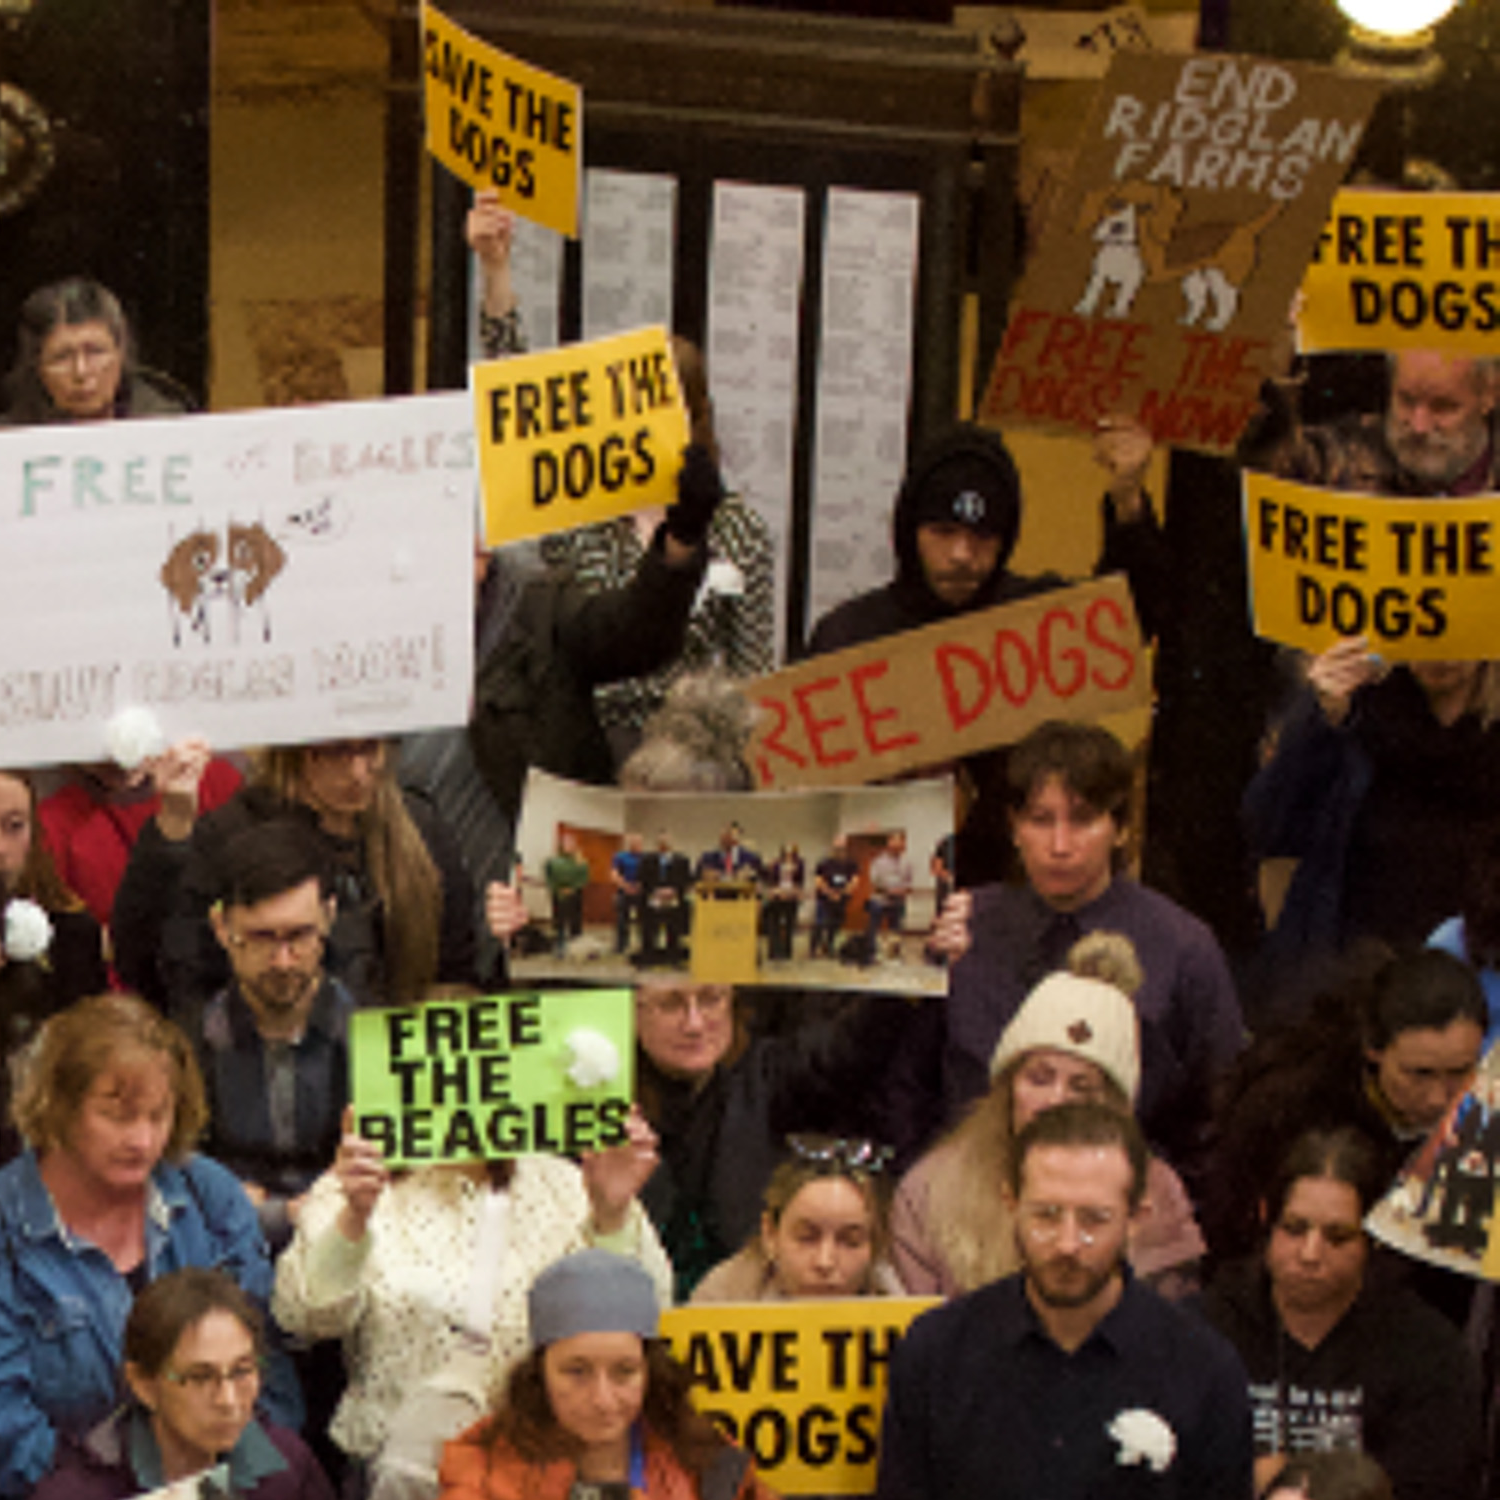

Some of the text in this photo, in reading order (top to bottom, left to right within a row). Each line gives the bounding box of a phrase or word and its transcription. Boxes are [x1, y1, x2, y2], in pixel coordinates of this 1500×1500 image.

[425, 30, 572, 154] SAVE THE
[1174, 57, 1298, 111] END
[450, 106, 535, 199] DOGS
[1104, 94, 1362, 164] RIDGLAN
[1113, 142, 1312, 200] FARMS
[1349, 277, 1500, 332] DOGS
[1001, 308, 1271, 392] FREE THE
[488, 352, 674, 445] FREE THE
[1136, 389, 1258, 448] NOW
[19, 455, 195, 517] FREE
[531, 428, 655, 509] DOGS
[1258, 497, 1493, 578] FREE THE
[1298, 573, 1449, 642] DOGS
[755, 597, 1137, 786] REE DOGS
[388, 1000, 542, 1057] FREE
[389, 1055, 511, 1105] THE
[360, 1097, 631, 1159] BEAGLES
[645, 1325, 901, 1393] AVE TH
